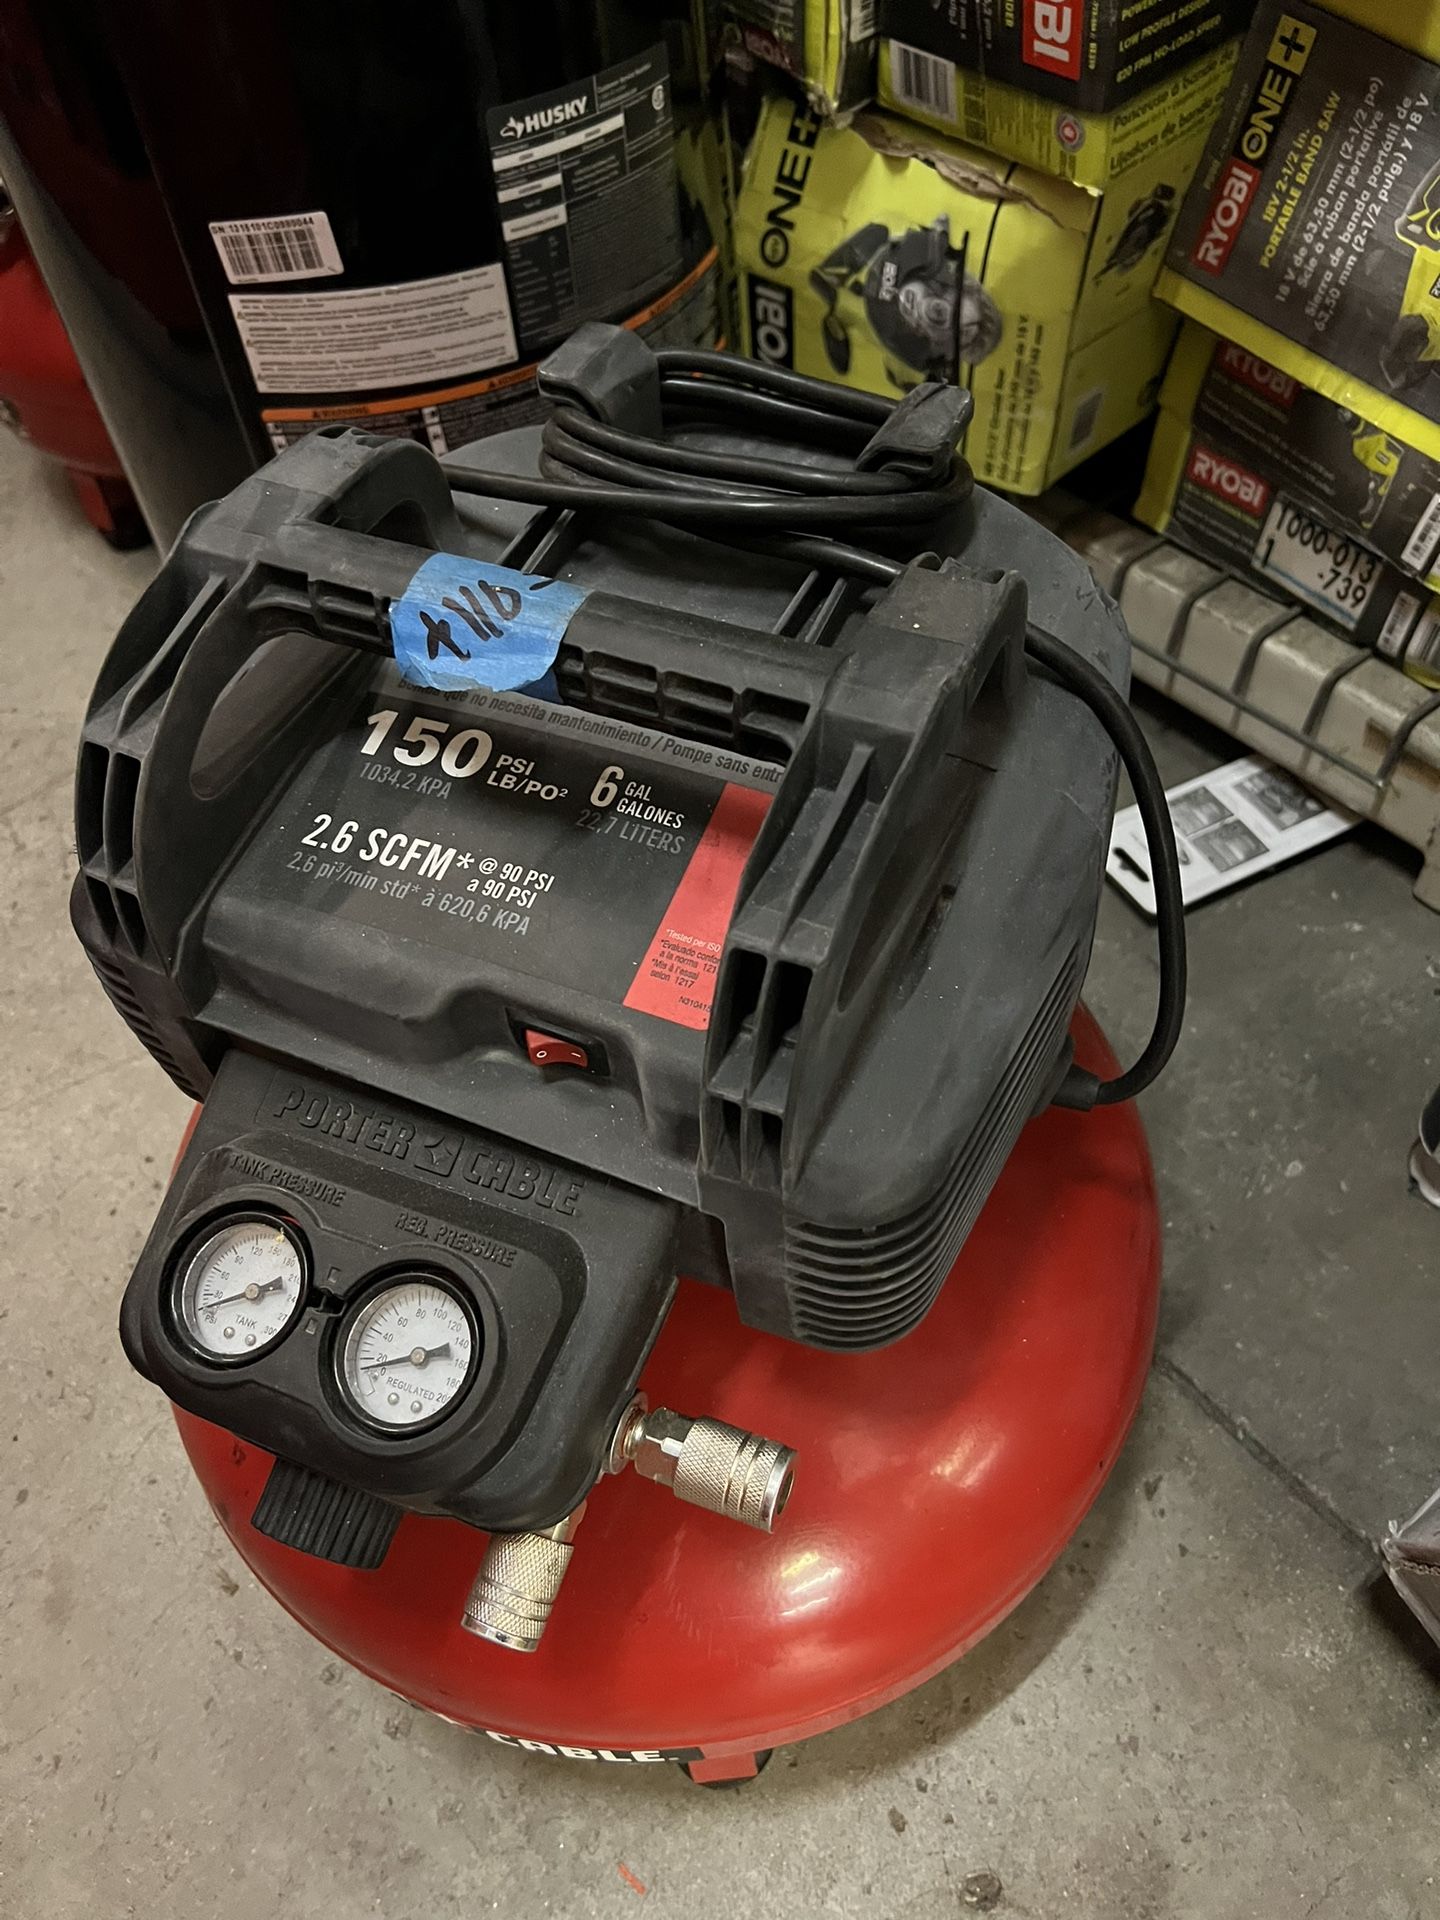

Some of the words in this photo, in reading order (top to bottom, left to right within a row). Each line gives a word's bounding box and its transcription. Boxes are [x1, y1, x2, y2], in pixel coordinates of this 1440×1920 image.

[525, 95, 588, 133] HUSKY
[1259, 186, 1303, 268] PORTABLE
[1295, 133, 1323, 186] BAND
[1318, 89, 1342, 133] SAW
[1263, 191, 1280, 223] 18V
[1275, 152, 1300, 191] 2-1/2
[1293, 129, 1312, 150] in.
[1323, 189, 1349, 240] ruban
[1345, 109, 1385, 188] portative
[1197, 165, 1254, 268] RYOBI
[1284, 267, 1297, 281] V
[1293, 246, 1308, 267] de
[1303, 198, 1330, 244] 63,50
[1326, 162, 1345, 196] mm
[1304, 268, 1333, 317] Sierra
[1330, 246, 1344, 268] de
[1338, 189, 1371, 244] banda
[1366, 122, 1401, 189] portátil
[1396, 95, 1413, 119] de
[1313, 288, 1341, 332] 63,50
[1338, 253, 1358, 287] mm
[1352, 202, 1382, 254] (2-1/2
[1377, 151, 1409, 203] pulg.)
[1405, 110, 1424, 132] 18
[1415, 92, 1431, 107] V
[1193, 451, 1265, 508] RYOBI
[1276, 503, 1377, 585] 1000-013
[361, 709, 493, 778] 150
[470, 692, 487, 708] no
[488, 695, 547, 722] necesita
[546, 710, 652, 748] mantenimiento
[661, 738, 714, 772] Pompe
[714, 752, 750, 775] sans
[496, 754, 536, 775] PSI
[416, 775, 454, 800] KPA
[589, 765, 625, 808] 6
[625, 781, 651, 802] GAL
[616, 798, 686, 829] GALONES
[300, 813, 359, 854] 2.6
[575, 809, 617, 843] 22,7
[618, 821, 687, 855] LITERS
[478, 857, 499, 875] @
[499, 861, 524, 884] 90
[524, 870, 556, 894] PSI
[286, 851, 318, 874] 2,6
[421, 887, 435, 908] à
[437, 892, 492, 925] 620,6
[491, 906, 532, 936] KPA
[466, 877, 480, 893] a
[481, 881, 505, 901] 90
[505, 887, 539, 910] PSI
[692, 938, 707, 949] per
[707, 942, 721, 953] ISO
[649, 968, 671, 982] selon
[674, 976, 696, 990] 1217
[665, 950, 674, 961] la
[674, 955, 700, 969] norma
[702, 962, 718, 975] 121
[272, 1086, 418, 1162] PORTER
[461, 1148, 588, 1217] CABLE
[230, 1153, 271, 1180] TANK
[271, 1165, 349, 1208] PRESSURE
[250, 1245, 264, 1257] 120
[395, 1210, 430, 1237] REG.
[433, 1223, 518, 1269] PRESSURE
[220, 1270, 231, 1281] 60
[213, 1289, 224, 1299] 30
[235, 1314, 259, 1330] TANK
[397, 1317, 409, 1328] 60
[415, 1307, 427, 1320] 80
[432, 1307, 448, 1321] 100
[446, 1319, 462, 1333] 120
[382, 1332, 394, 1343] 40
[454, 1336, 470, 1350] 140
[376, 1352, 388, 1364] 20
[380, 1367, 387, 1377] 0
[385, 1376, 436, 1401] REGULATED
[445, 1376, 462, 1390] 180
[485, 1730, 666, 1763] CABLE
